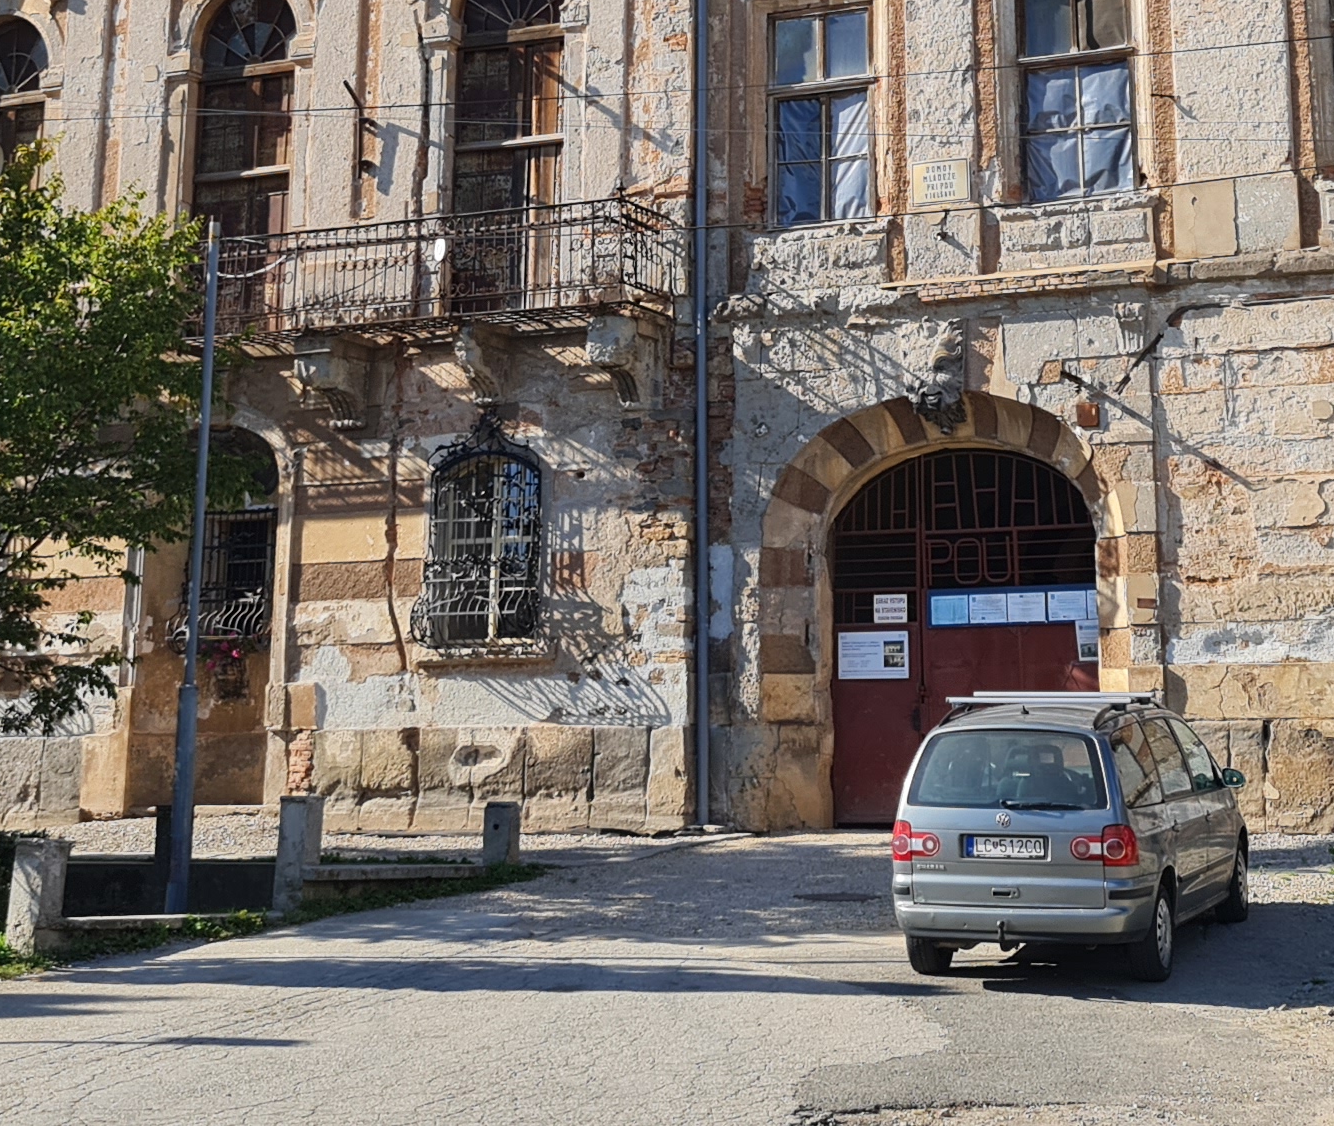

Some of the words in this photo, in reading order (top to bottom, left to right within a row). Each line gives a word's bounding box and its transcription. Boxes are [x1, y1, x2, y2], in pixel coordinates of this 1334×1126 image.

[926, 165, 952, 173] DOMOV
[926, 536, 1011, 585] POU
[975, 839, 992, 853] LC
